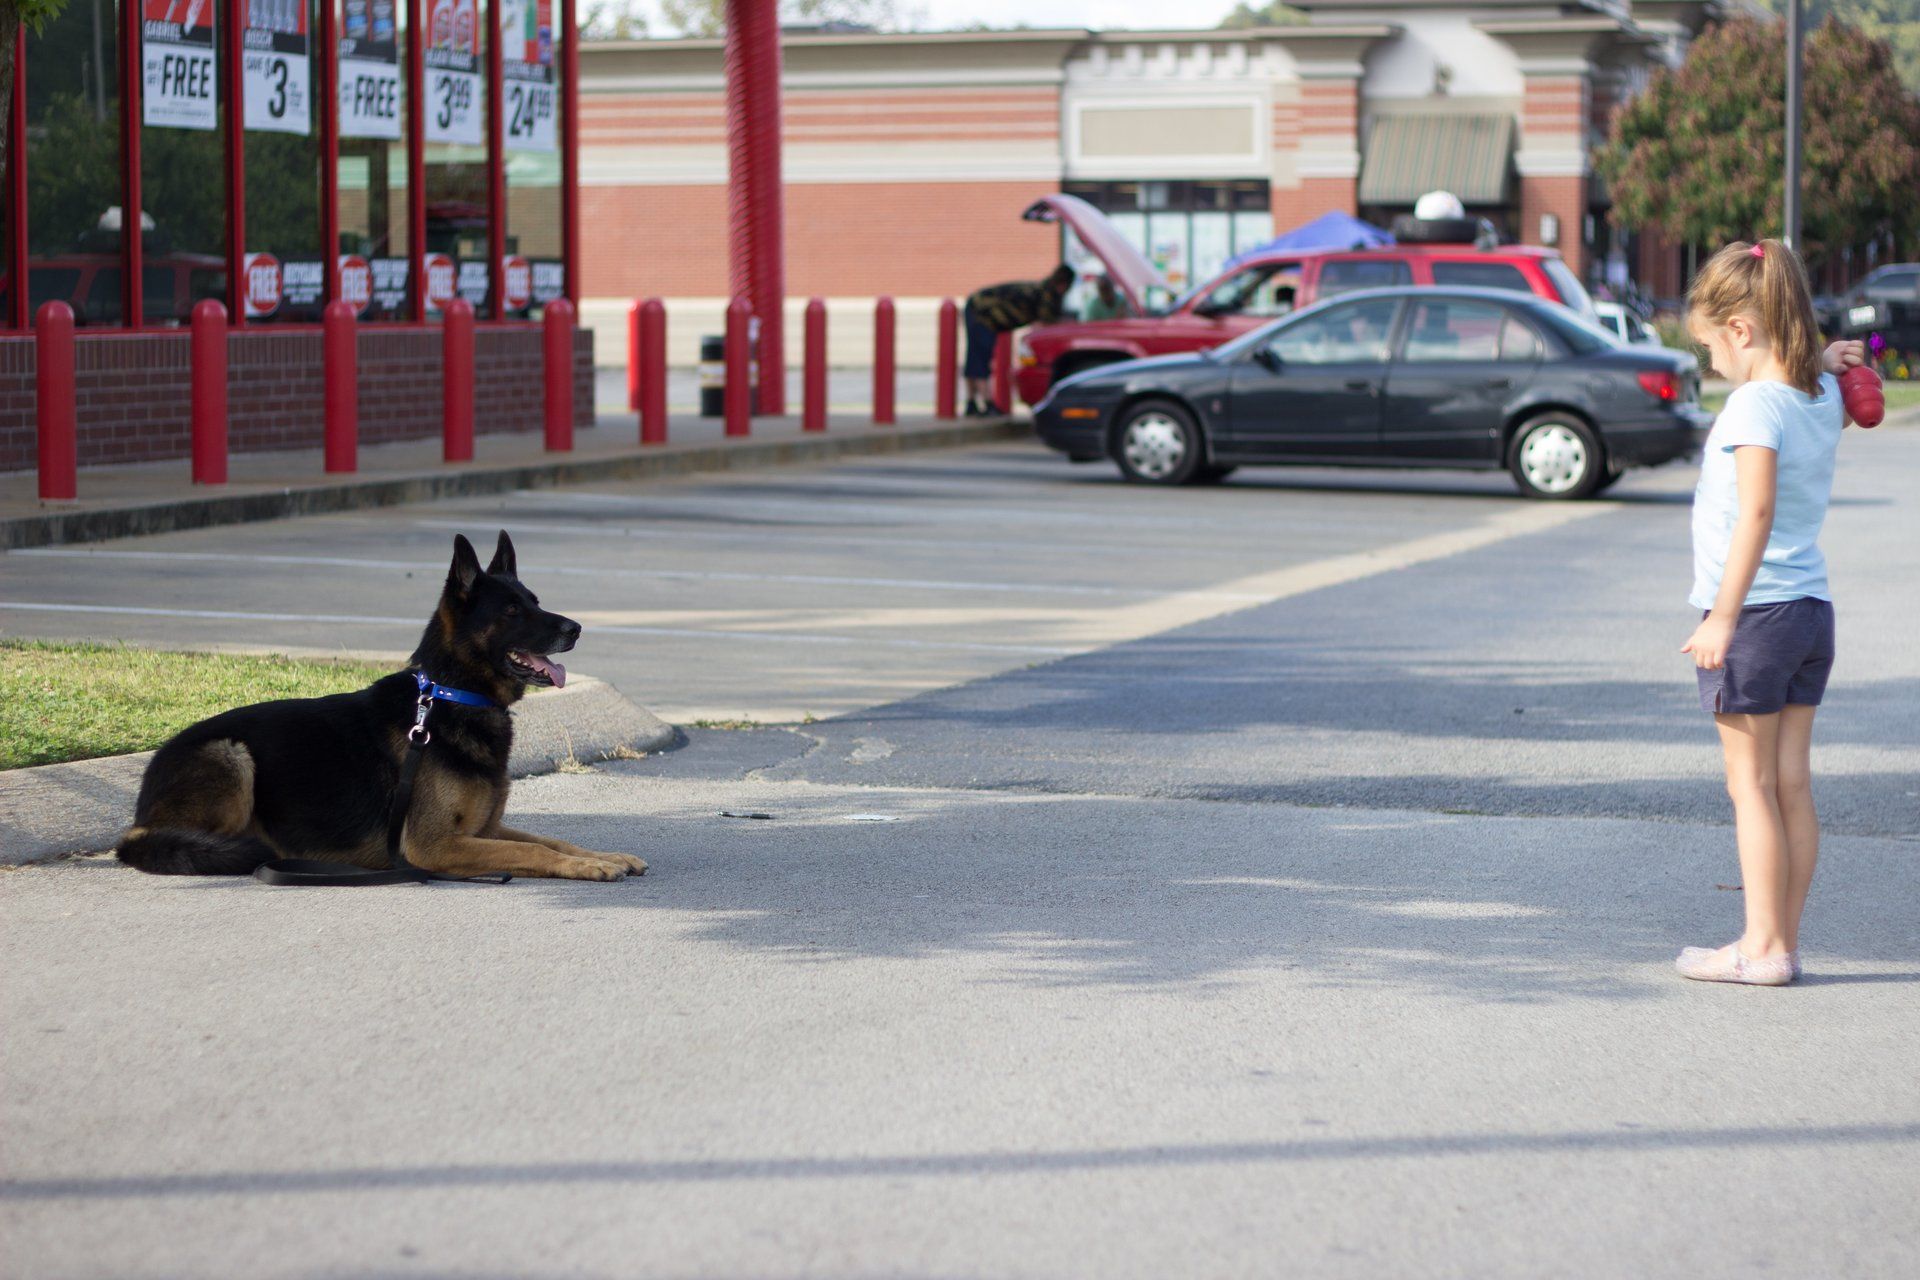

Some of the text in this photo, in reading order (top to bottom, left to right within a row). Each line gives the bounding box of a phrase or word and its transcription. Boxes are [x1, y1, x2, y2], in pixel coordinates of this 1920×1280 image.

[161, 53, 211, 98] FREE
[353, 74, 396, 119] FREE
[249, 265, 278, 303] FREE
